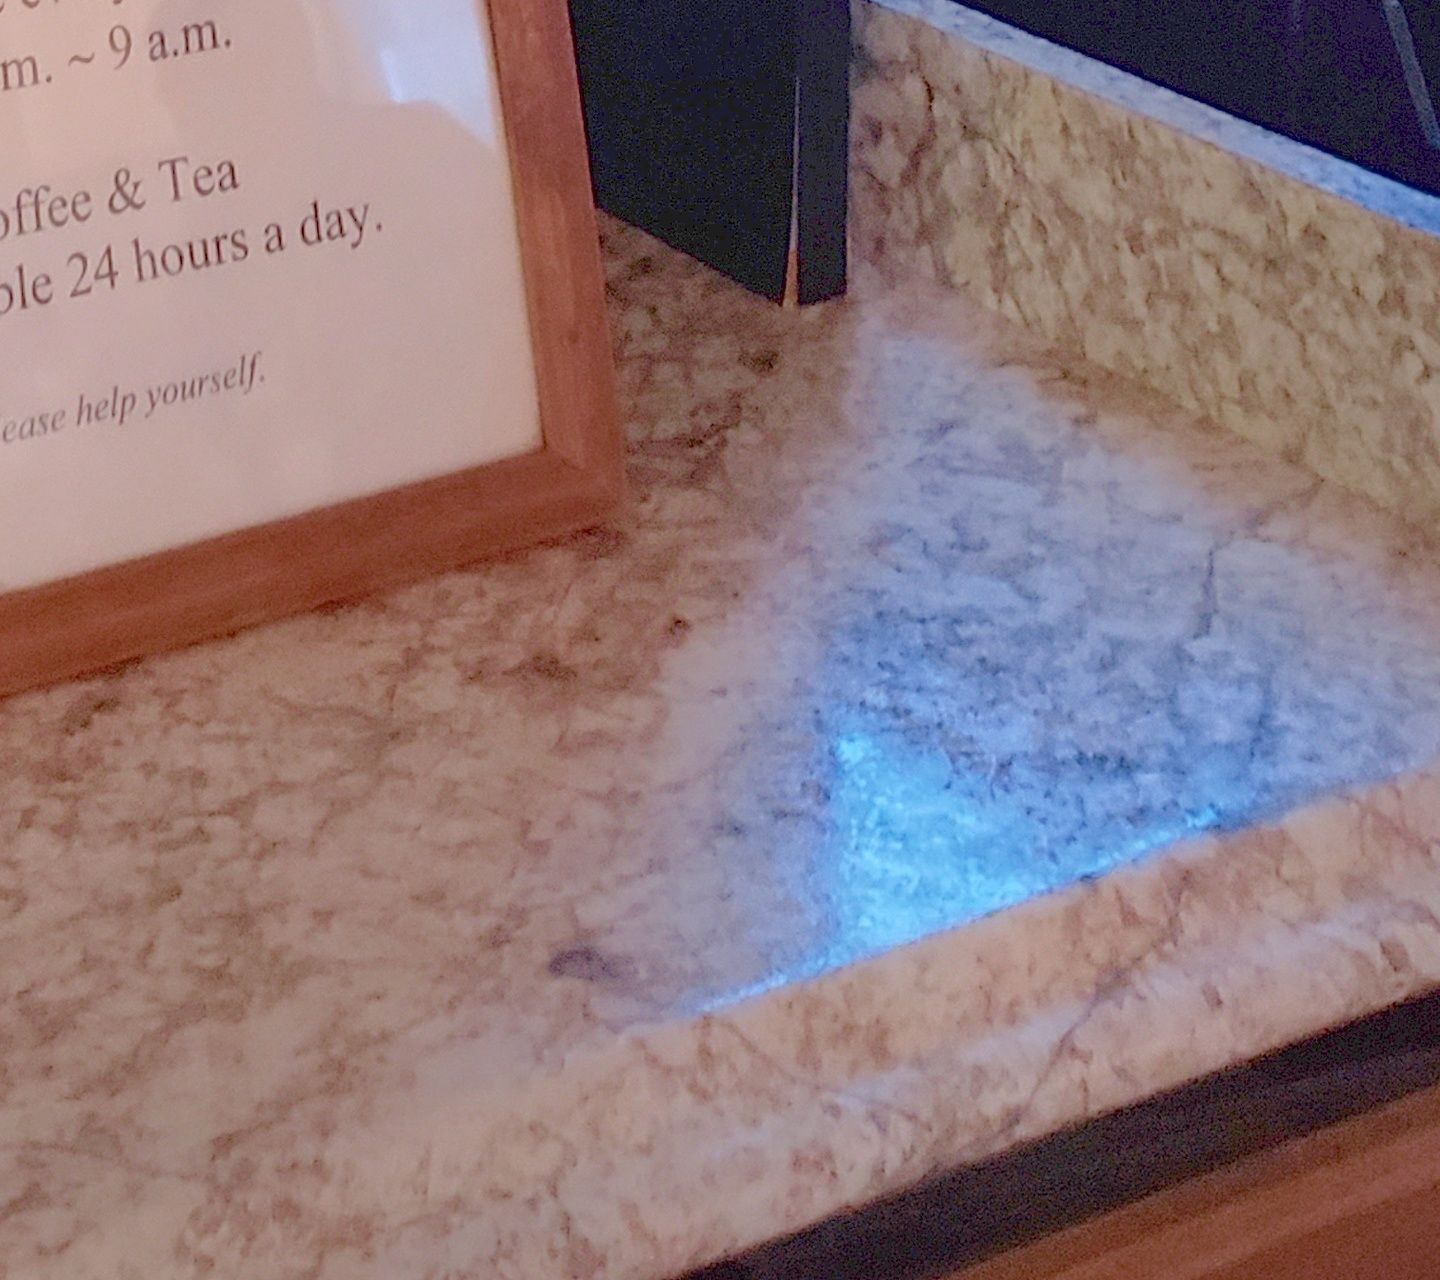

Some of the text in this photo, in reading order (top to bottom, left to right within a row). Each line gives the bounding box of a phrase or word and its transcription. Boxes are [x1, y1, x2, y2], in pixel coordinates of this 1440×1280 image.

[107, 24, 134, 70] 9
[147, 18, 233, 64] a.m.
[107, 166, 147, 215] &
[157, 155, 241, 202] Tea
[66, 243, 120, 300] 24
[131, 222, 250, 283] hours
[263, 222, 286, 255] a
[298, 199, 384, 250] day.
[75, 384, 138, 426] help
[143, 352, 266, 420] yourself.
